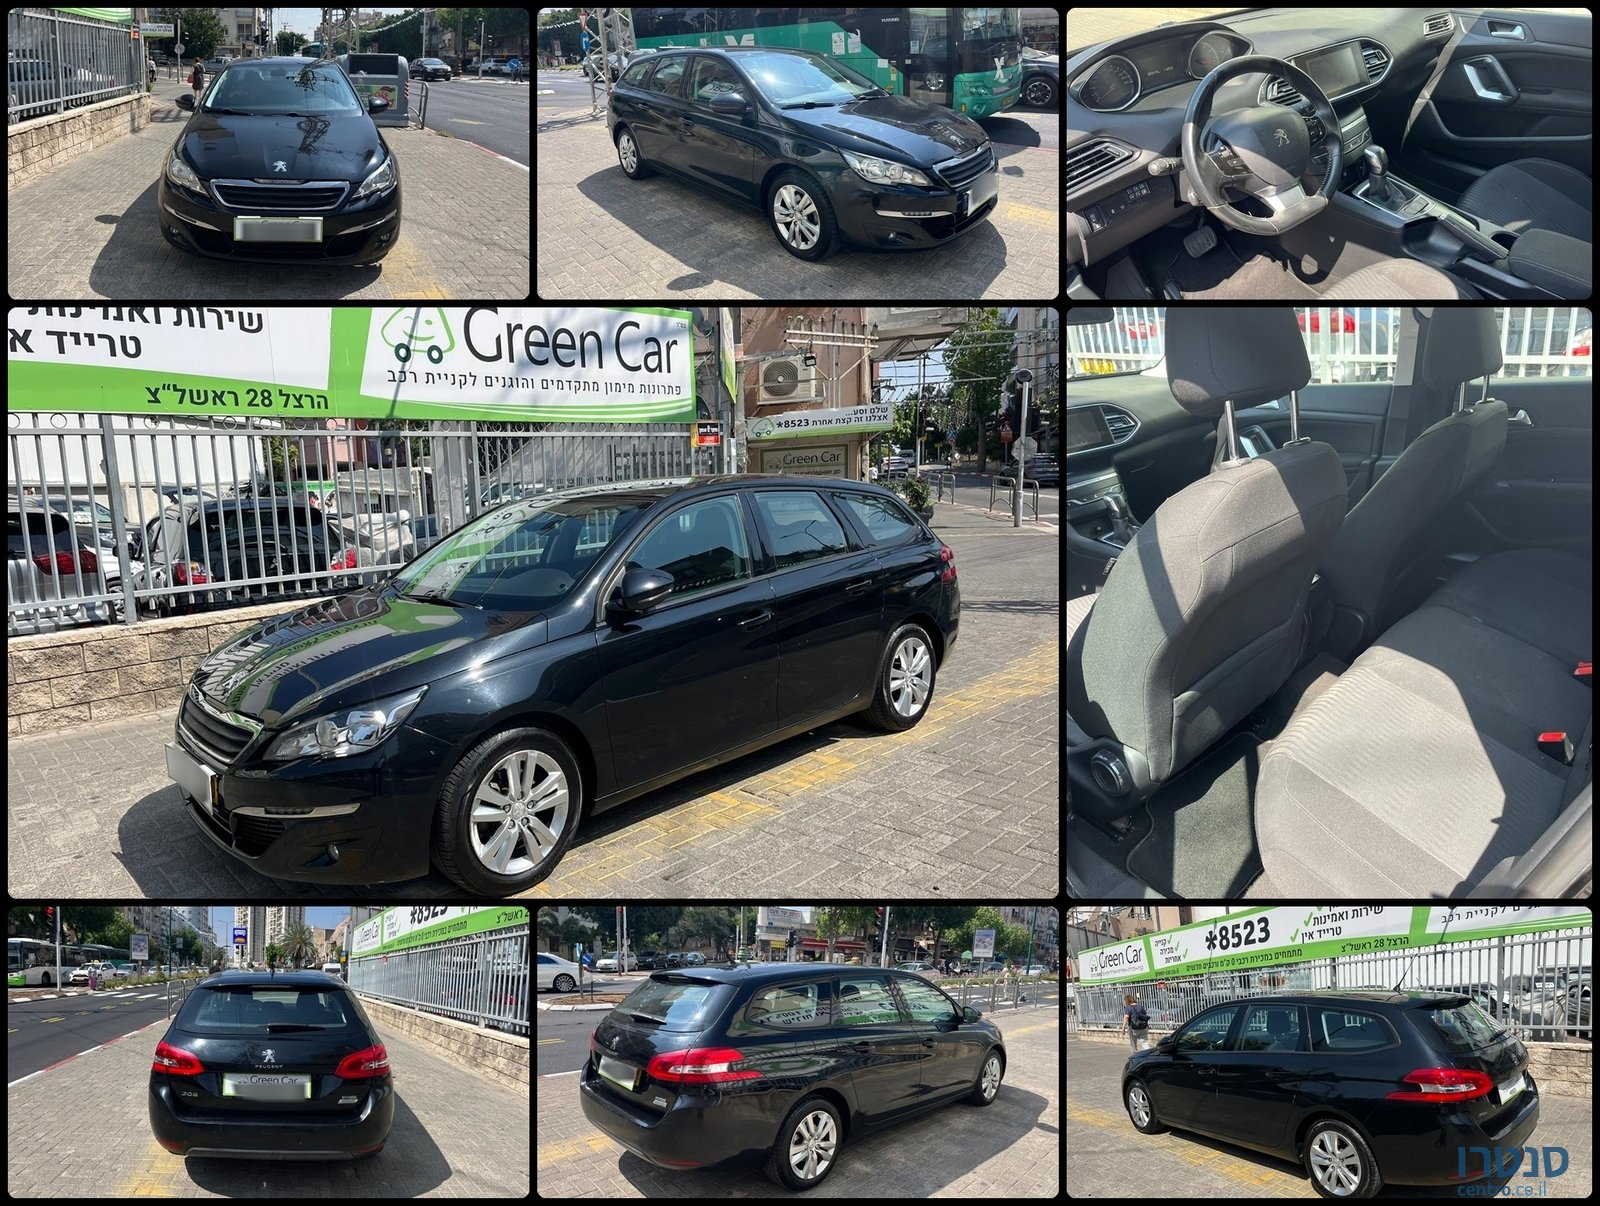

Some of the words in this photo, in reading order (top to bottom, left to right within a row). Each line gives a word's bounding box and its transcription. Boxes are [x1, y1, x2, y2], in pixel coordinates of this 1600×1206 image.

[173, 307, 263, 334] שירות
[46, 330, 142, 359] טרייד
[463, 307, 603, 369] Green
[615, 320, 678, 374] Car
[387, 369, 418, 384] רכב
[425, 370, 478, 390] לקניית
[484, 375, 535, 390] והוגנים
[541, 379, 600, 394] מתקדמים
[604, 382, 635, 396] מימון
[639, 383, 682, 396] פתרונות
[245, 388, 273, 408] 28
[278, 389, 329, 410] הרצל
[870, 406, 888, 414] שלם
[811, 418, 833, 427] אחרת
[835, 417, 852, 426] קצת
[865, 414, 888, 422] אצלנו
[783, 452, 819, 466] Green
[820, 450, 841, 463] Car
[1312, 910, 1349, 926] ואמינות
[1351, 906, 1384, 919] שירות
[1301, 929, 1315, 944] אין
[1315, 926, 1342, 938] טרייד
[1374, 937, 1385, 948] 28
[1386, 935, 1409, 947] הרצל
[1098, 950, 1125, 969] Green
[1125, 945, 1143, 964] Car
[1274, 948, 1303, 960] מתמחים
[250, 1075, 279, 1085] Green
[281, 1075, 299, 1085] Car
